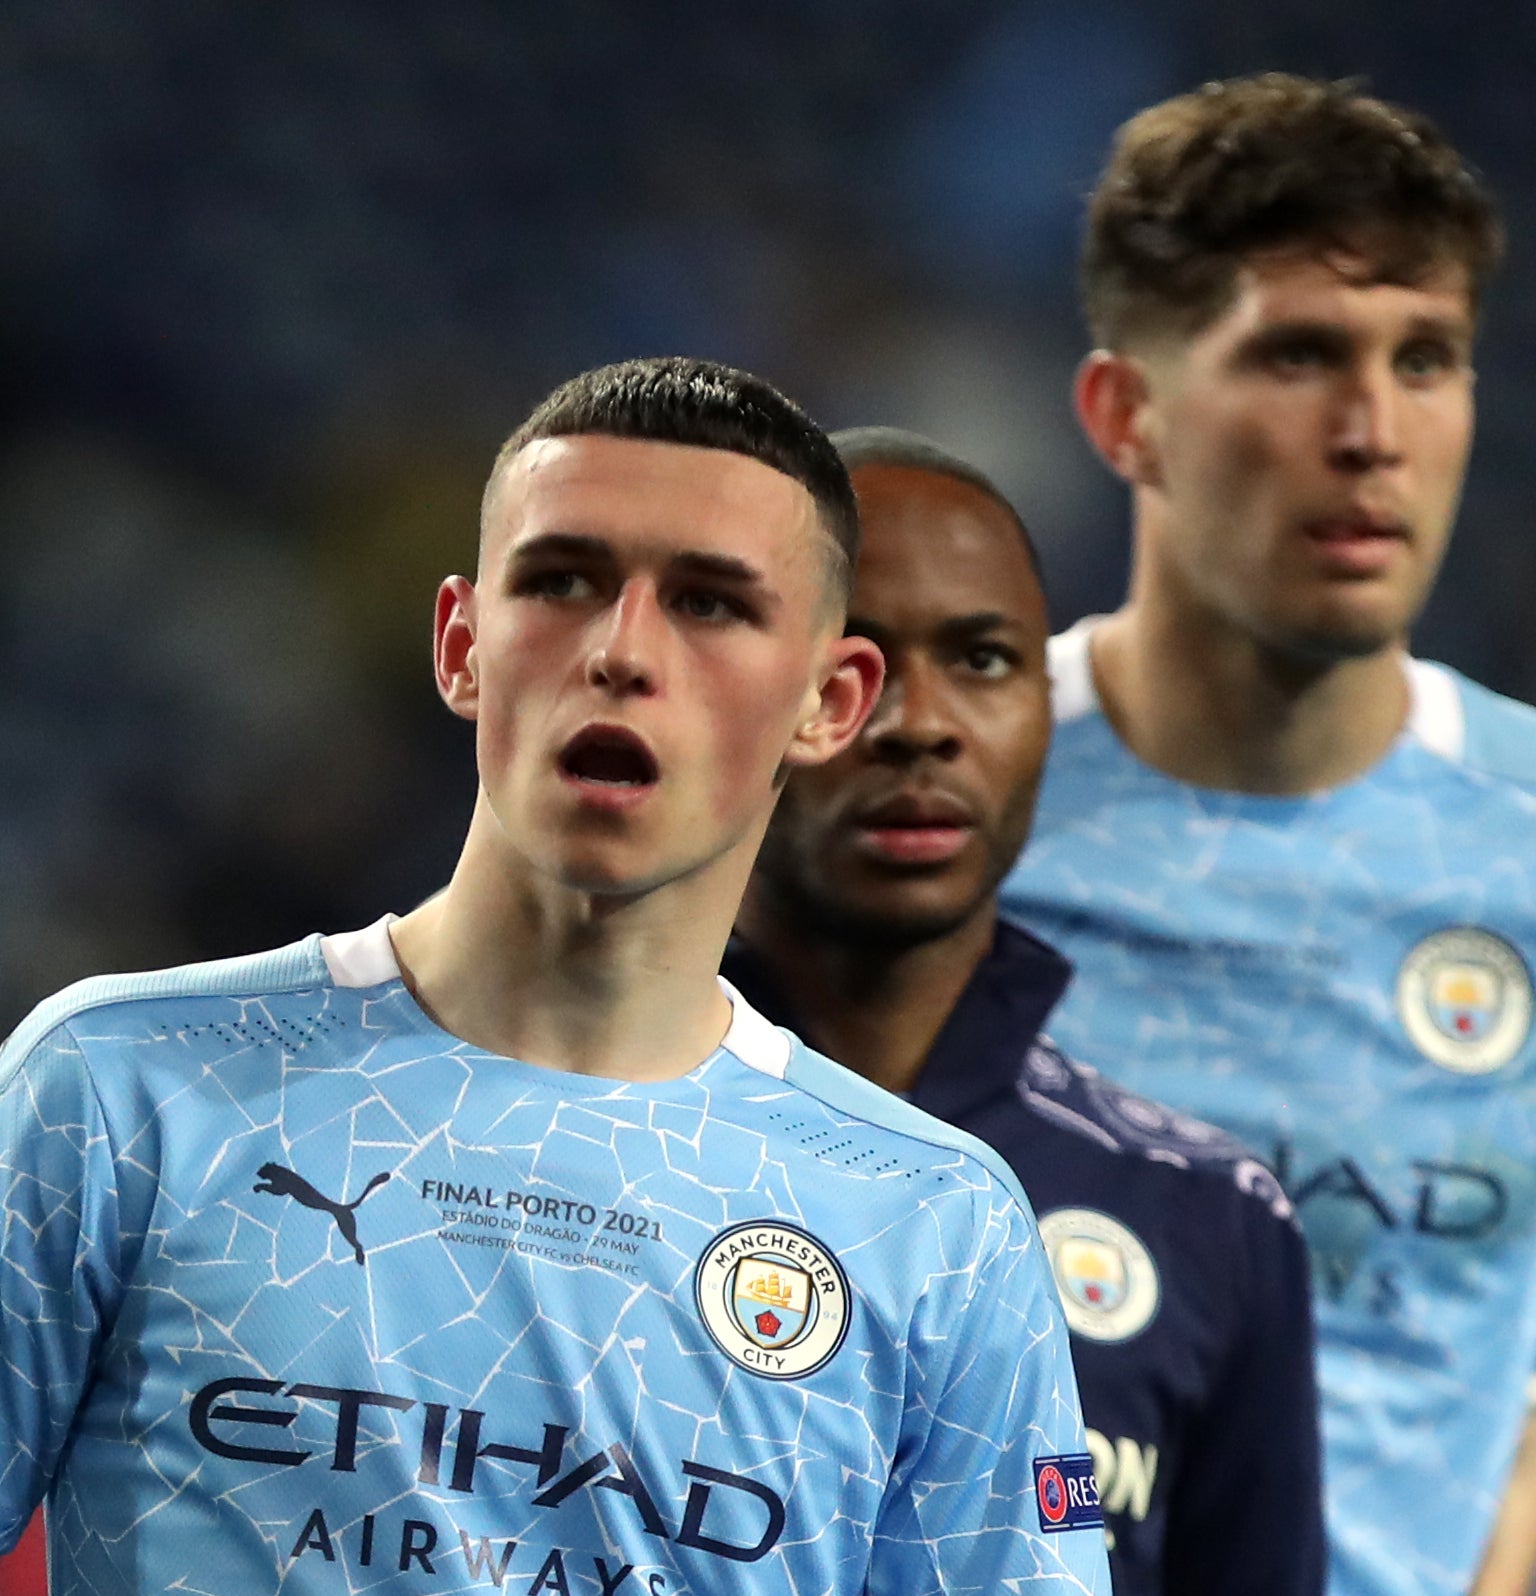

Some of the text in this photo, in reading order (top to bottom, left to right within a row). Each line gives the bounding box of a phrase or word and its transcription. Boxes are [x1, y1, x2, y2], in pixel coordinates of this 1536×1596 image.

[421, 1179, 663, 1242] FINAL PORTO 2021
[501, 1217, 521, 1231] DO
[592, 1234, 608, 1249] 29
[610, 1239, 640, 1256] MAY
[437, 1230, 515, 1250] MANCHESTER
[518, 1242, 543, 1255] CITY
[544, 1247, 557, 1259] FC
[573, 1253, 624, 1272] CHELSEA
[625, 1265, 640, 1276] FC
[715, 1233, 836, 1295] MANCHESTER
[743, 1348, 786, 1370] CITY
[188, 1376, 786, 1564] ETIHAD
